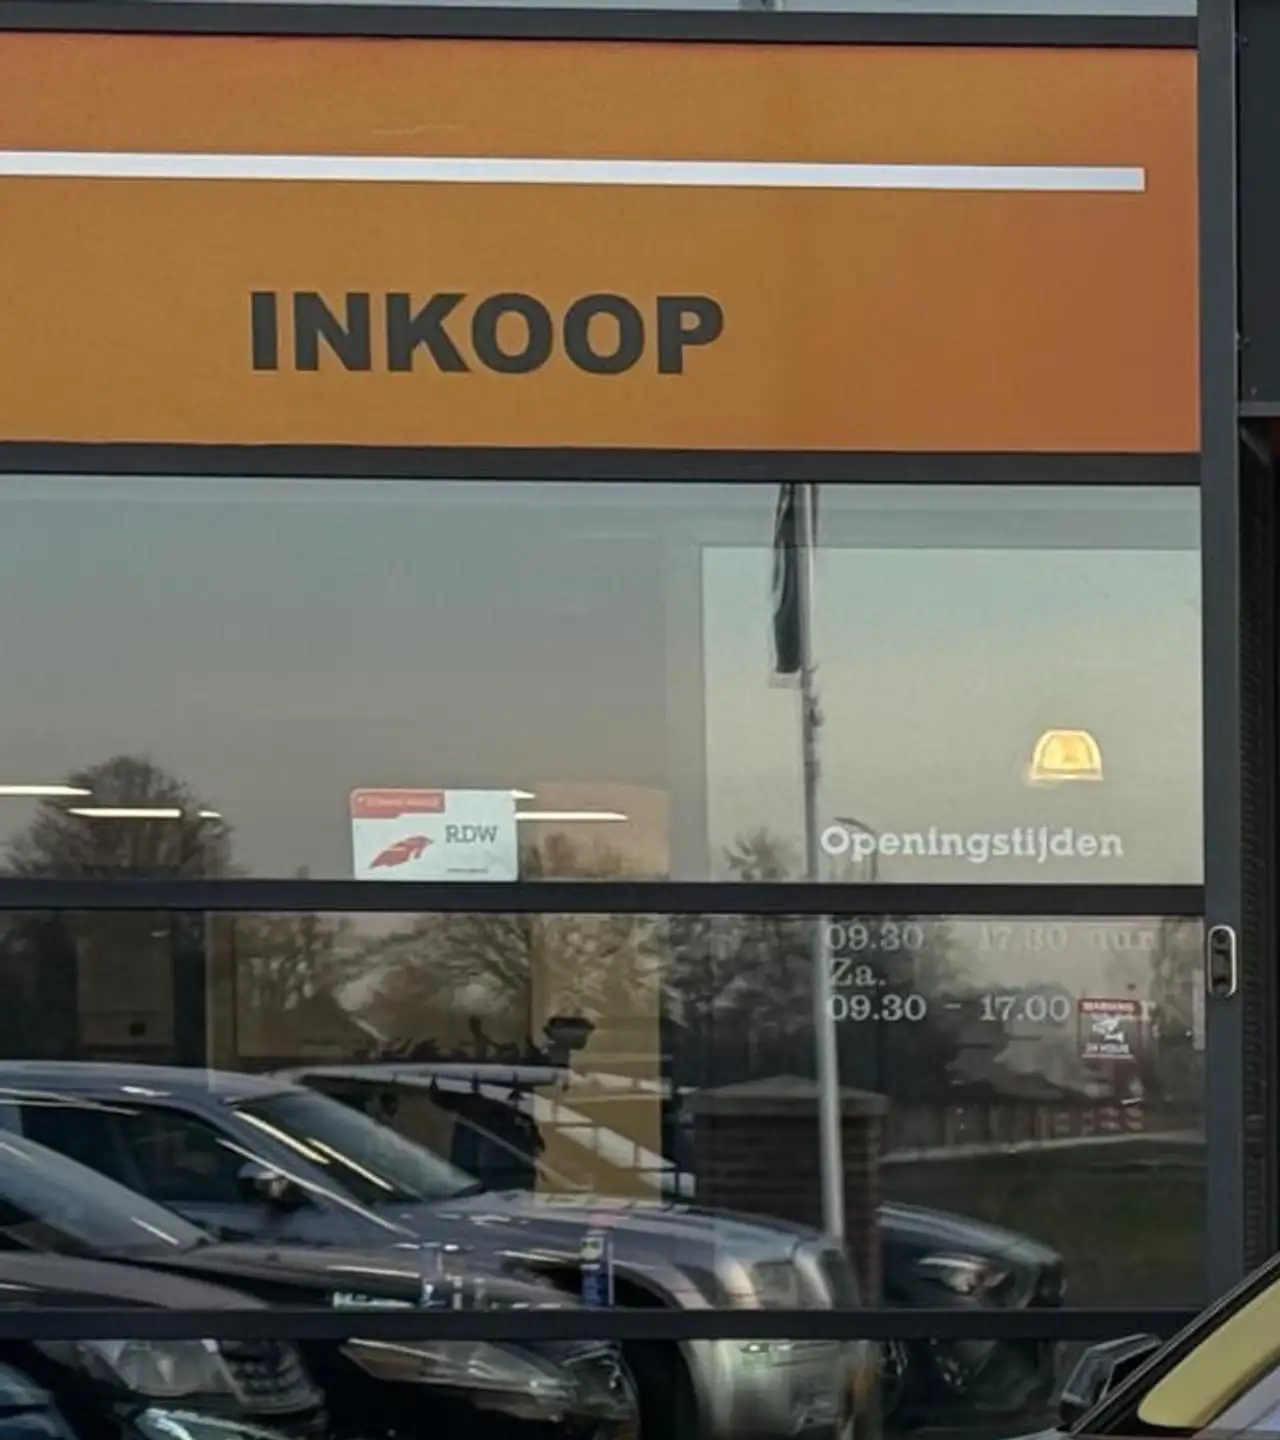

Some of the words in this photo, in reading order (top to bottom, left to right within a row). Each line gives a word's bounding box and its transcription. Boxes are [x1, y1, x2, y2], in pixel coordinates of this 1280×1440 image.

[250, 290, 725, 376] INKOOP
[444, 824, 498, 844] RDW
[820, 825, 1125, 863] Openingstijden
[826, 922, 925, 951] 09.30
[829, 957, 887, 987] Za.
[826, 994, 927, 1022] 09.30
[979, 994, 1071, 1022] 17.00
